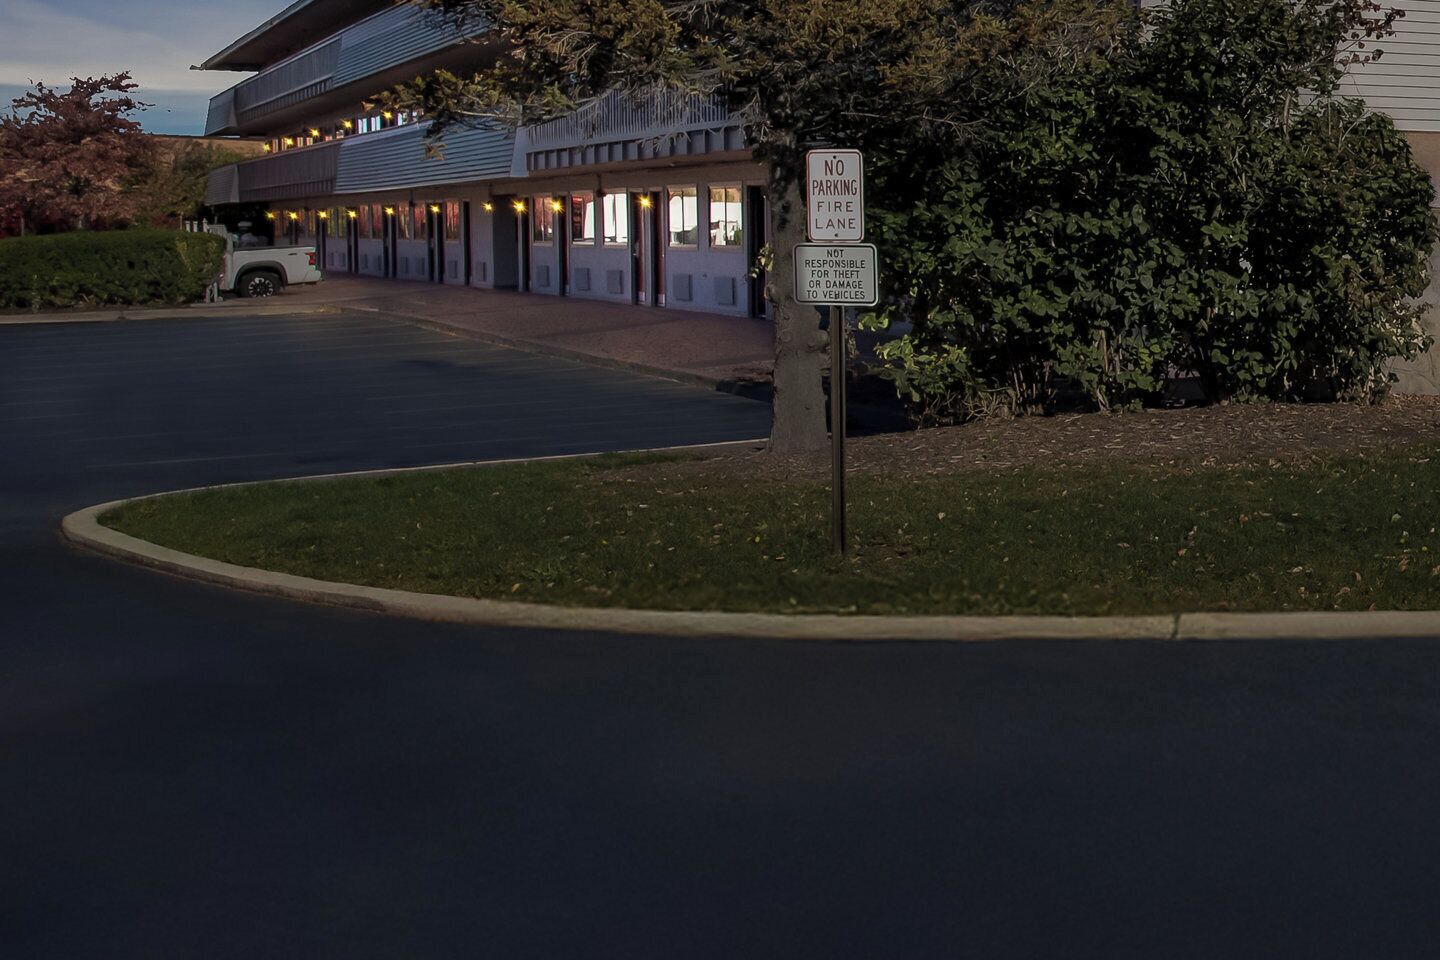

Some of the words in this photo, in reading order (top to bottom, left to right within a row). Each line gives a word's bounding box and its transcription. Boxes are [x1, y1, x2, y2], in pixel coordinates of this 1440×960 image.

[824, 159, 845, 176] NO
[812, 179, 858, 196] PARKING
[817, 201, 854, 213] FIRE
[815, 218, 857, 230] LANE
[826, 249, 845, 258] NOT
[804, 259, 866, 269] RESPONSIBLE
[811, 269, 830, 279] FOR
[833, 269, 860, 279] THEFT
[808, 279, 821, 289] OR
[825, 280, 863, 290] DAMAGE
[806, 290, 818, 299] TO
[822, 290, 866, 300] VEHICLES
